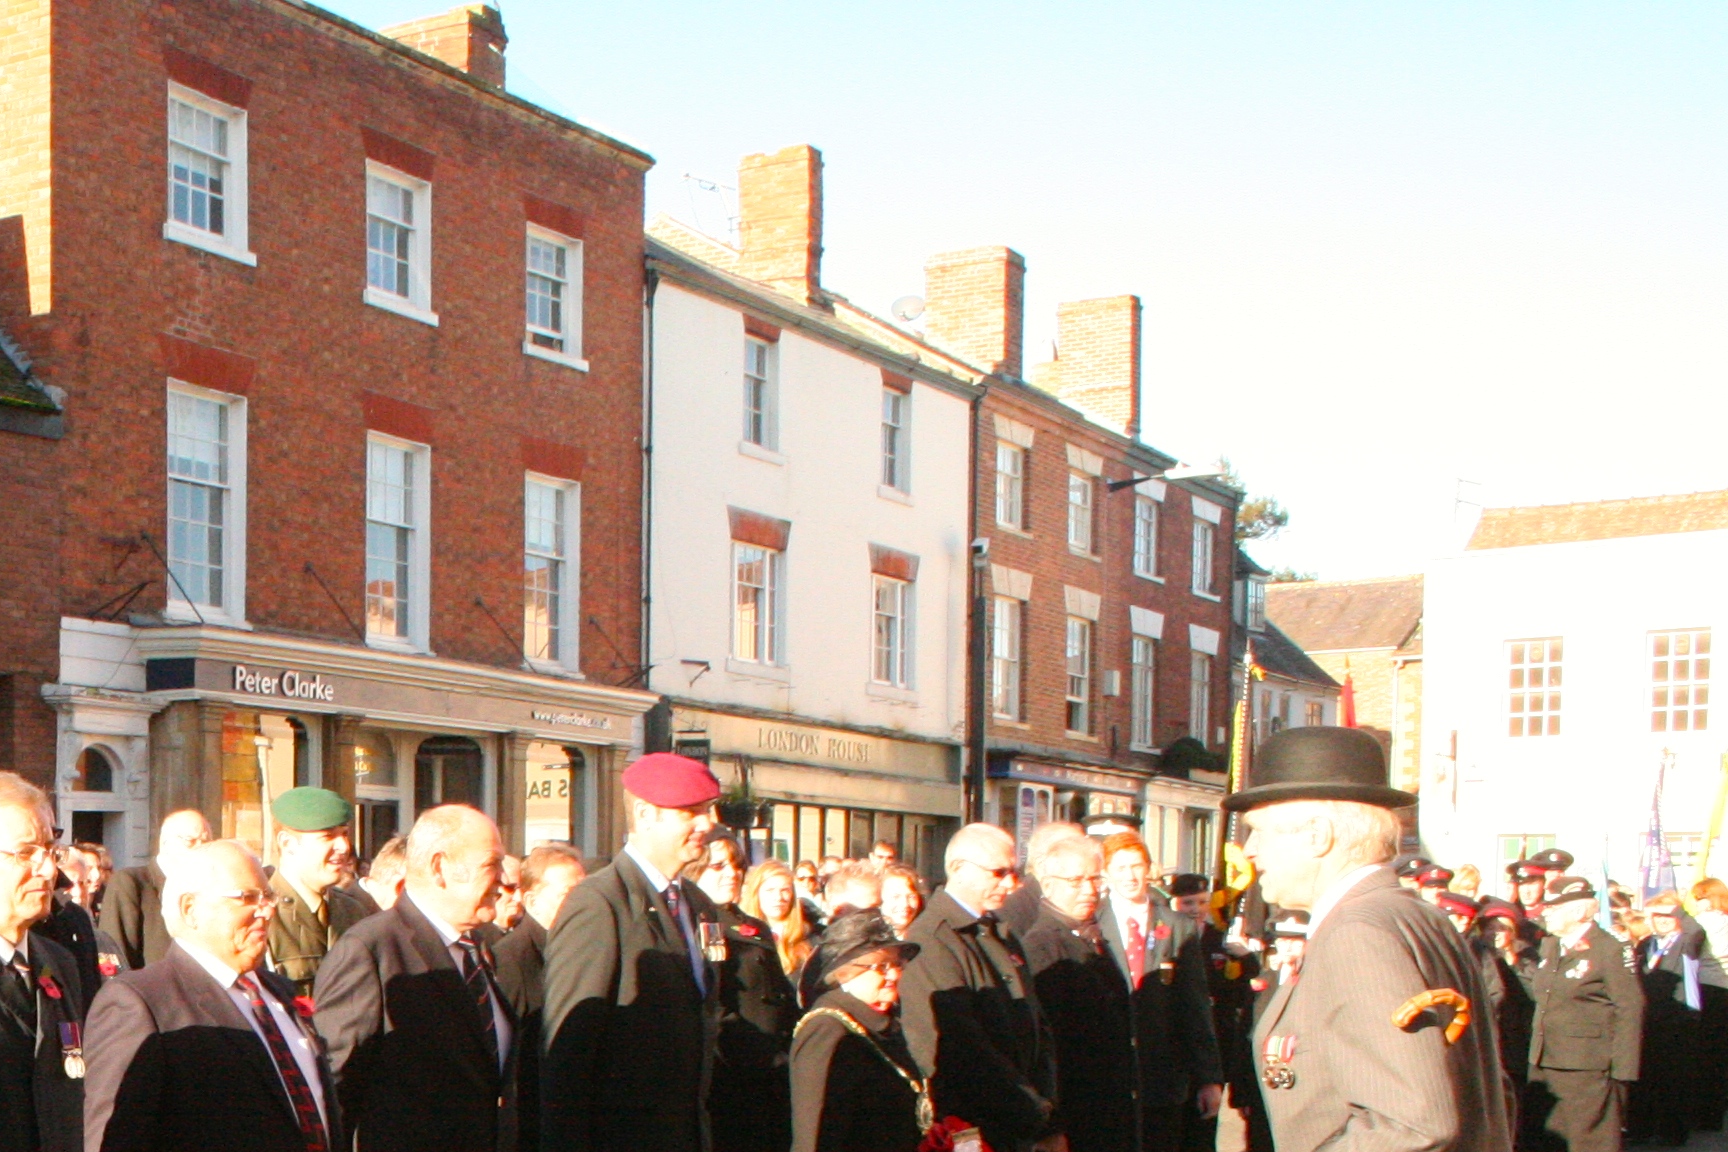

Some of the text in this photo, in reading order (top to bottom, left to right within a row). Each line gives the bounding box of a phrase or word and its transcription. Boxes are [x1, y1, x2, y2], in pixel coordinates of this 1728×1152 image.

[233, 664, 335, 701] Peter Clarke
[758, 727, 820, 756] LONDON
